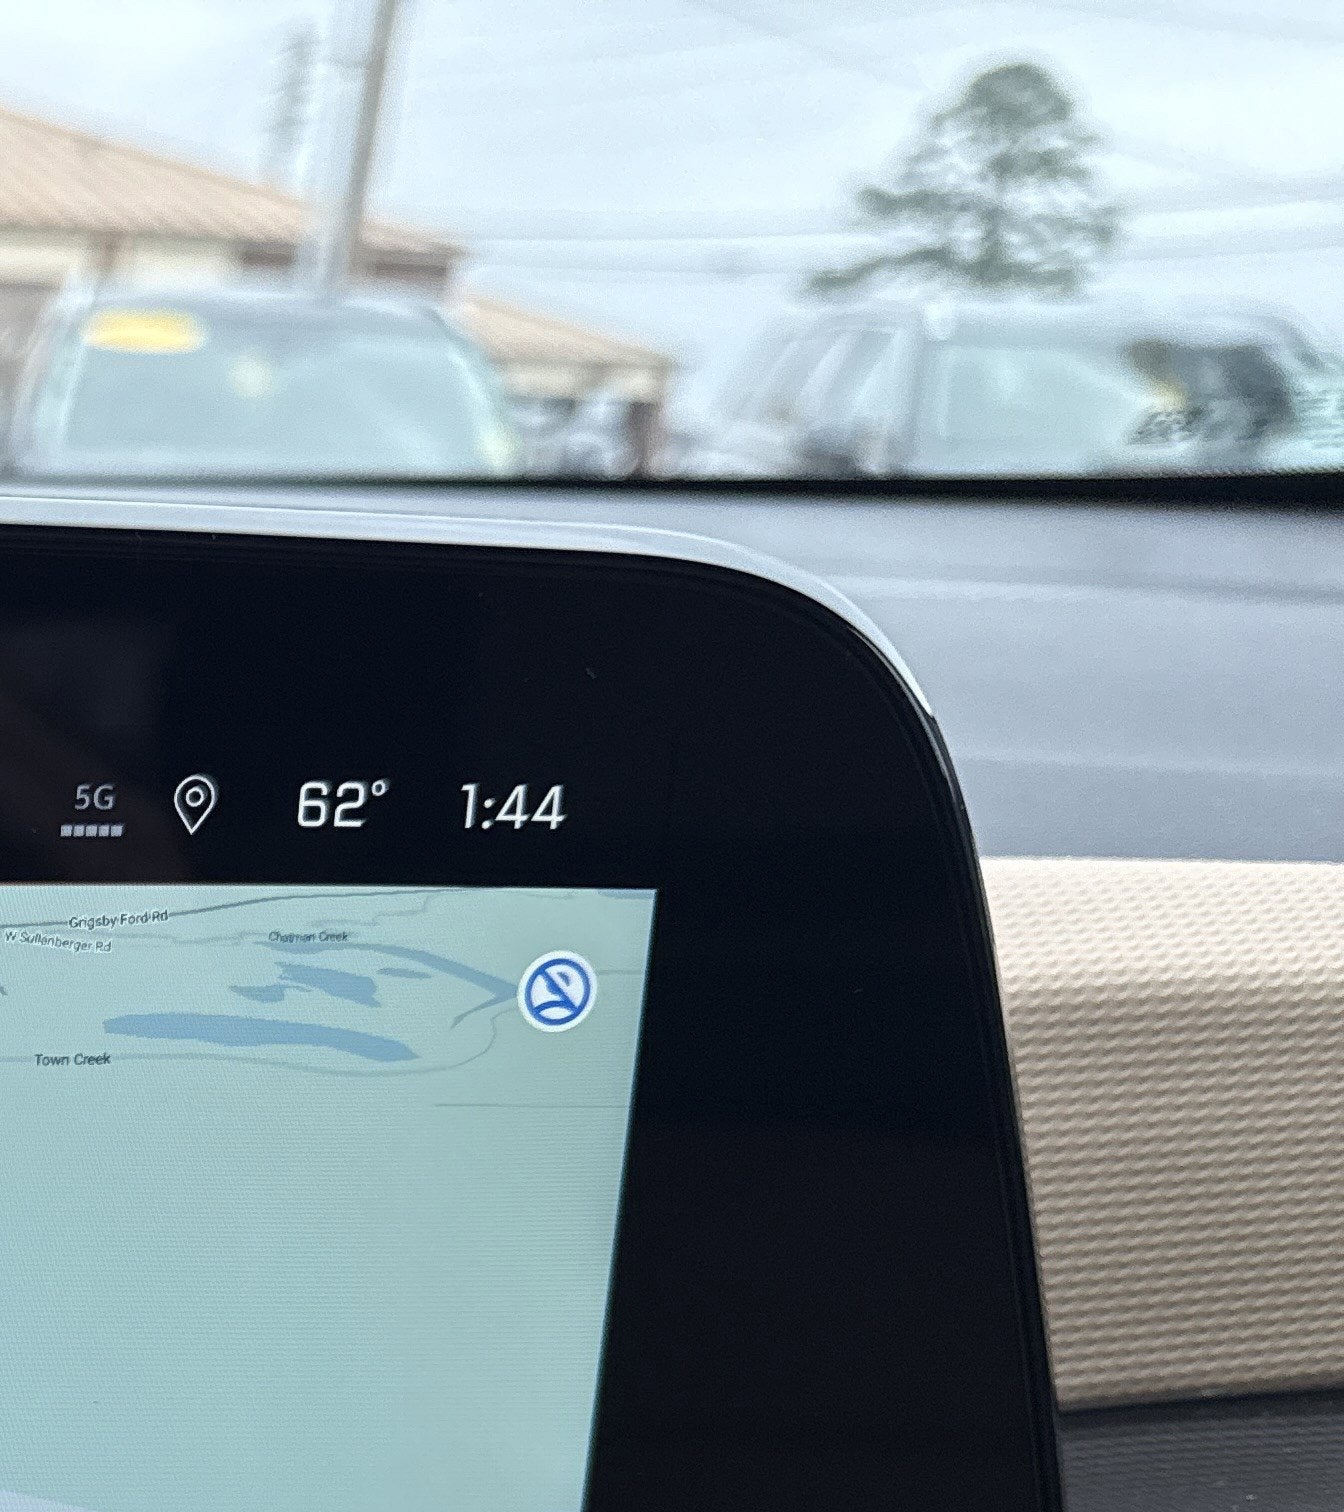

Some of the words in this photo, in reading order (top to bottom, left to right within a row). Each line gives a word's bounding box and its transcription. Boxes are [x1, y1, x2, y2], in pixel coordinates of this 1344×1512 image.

[74, 783, 115, 810] 5G
[296, 778, 389, 829] 62°
[459, 782, 567, 831] 1:44
[69, 915, 117, 930] Grigsby
[120, 911, 148, 925] Ford
[151, 910, 169, 922] Rd
[5, 932, 17, 942] W
[20, 932, 92, 951] Sullenberger
[95, 941, 112, 952] Rd
[36, 1053, 69, 1066] Town
[74, 1053, 111, 1066] Creek
